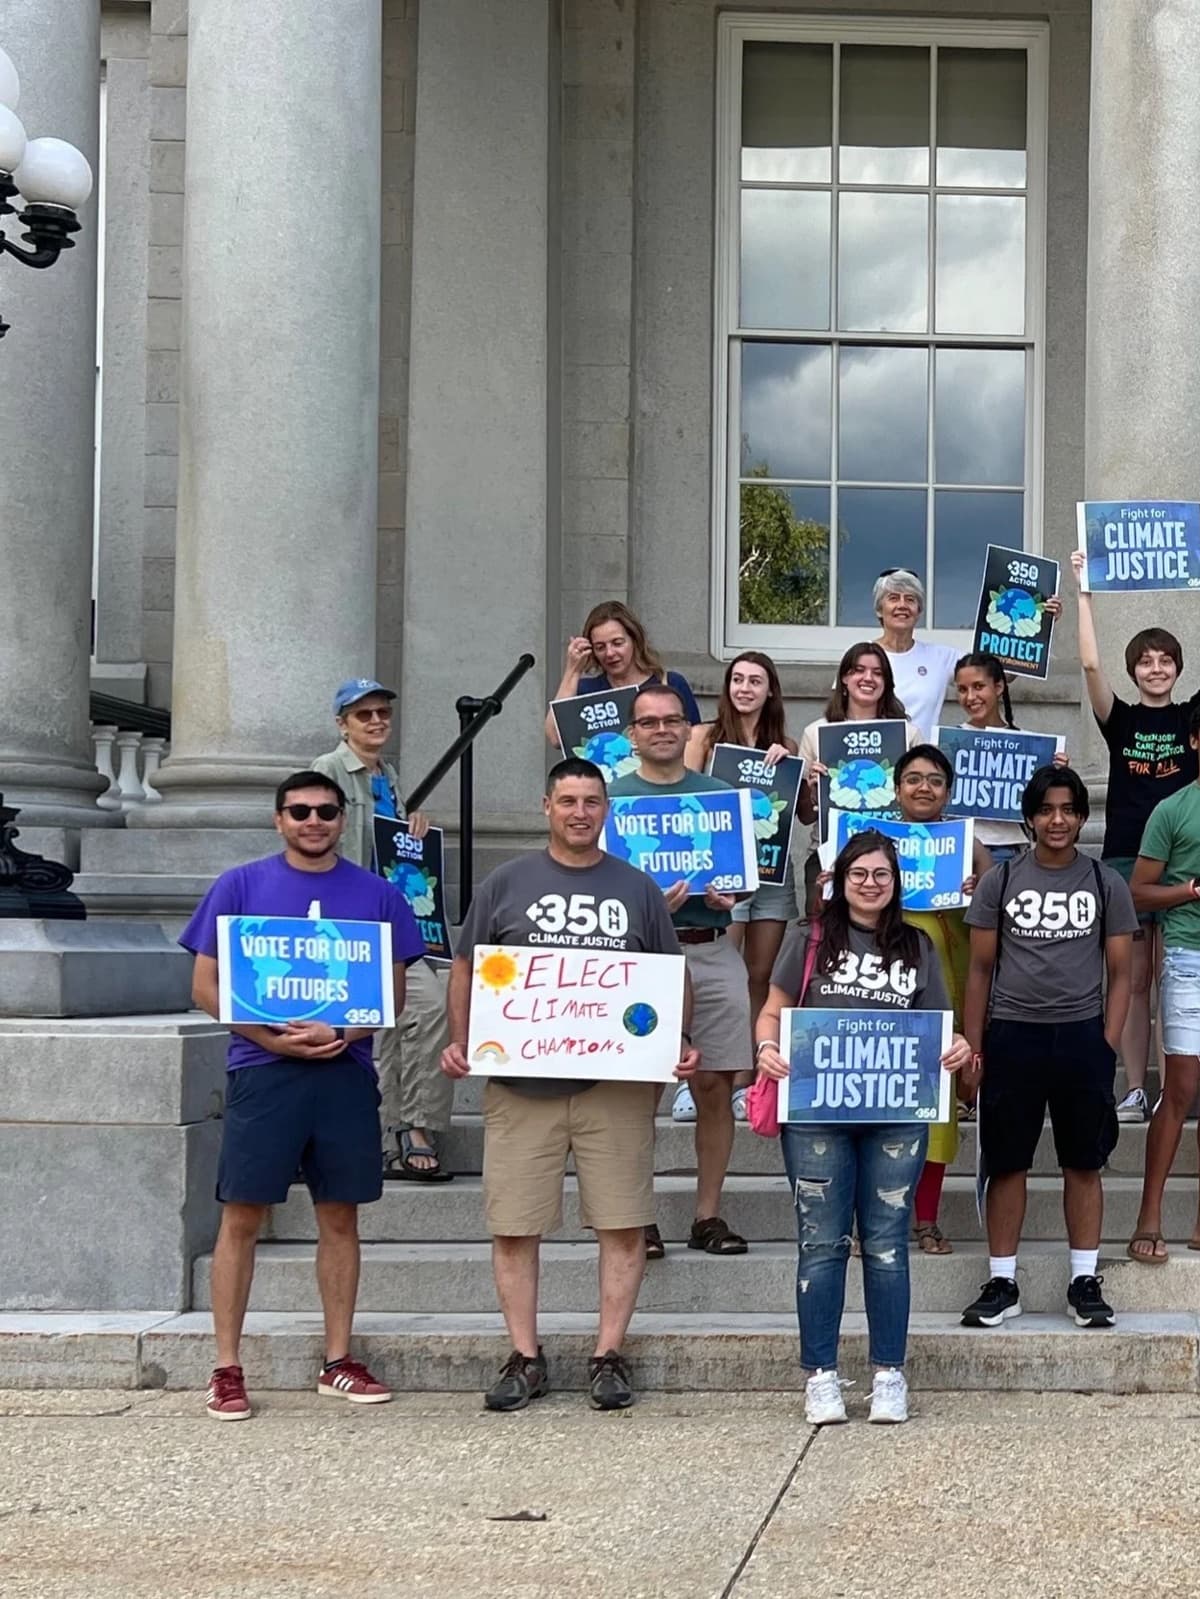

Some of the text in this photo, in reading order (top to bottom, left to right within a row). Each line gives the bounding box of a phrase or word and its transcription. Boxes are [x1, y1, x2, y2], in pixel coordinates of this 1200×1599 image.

[1120, 508, 1167, 521] Fight for
[1104, 521, 1187, 549] CLIMATE
[1008, 560, 1039, 580] 350
[1105, 551, 1190, 581] JUSTICE
[1008, 576, 1038, 588] ACTION
[979, 632, 1044, 663] PROTECT
[582, 701, 618, 722] 350
[587, 717, 620, 731] ACTION
[845, 731, 882, 748] 350
[974, 737, 1020, 750] Fight for
[847, 747, 881, 755] ACTION
[741, 759, 777, 779] 350
[955, 749, 1038, 781] CLIMATE
[1128, 759, 1177, 775] FOR ALL
[739, 775, 774, 786] ACTION
[951, 778, 1027, 811] JUSTIC
[614, 811, 732, 836] VOTE FOR OUR
[396, 850, 423, 860] ACTION
[924, 836, 956, 856] OUR
[639, 850, 714, 873] FUTURES
[713, 875, 743, 890] 350
[934, 892, 960, 907] 350
[1014, 889, 1097, 930] 350
[1077, 897, 1089, 922] NH
[535, 893, 629, 937] 350
[528, 932, 627, 950] CLIMATE JUSTICE
[1010, 926, 1053, 939] CLIMATE
[240, 935, 371, 963] VOTE FOR OUR
[524, 953, 638, 990] ELECT
[831, 949, 917, 996] 350
[266, 977, 349, 1002] FUTURES
[820, 984, 870, 999] CLIMATE
[345, 1008, 381, 1024] 350
[502, 999, 609, 1023] CLIMATE
[837, 1018, 896, 1034] Fight for
[520, 1036, 625, 1060] CHAMPIONS
[814, 1035, 920, 1070] CLIMATE
[811, 1072, 920, 1108] JUSTICE
[916, 1107, 937, 1119] 350
